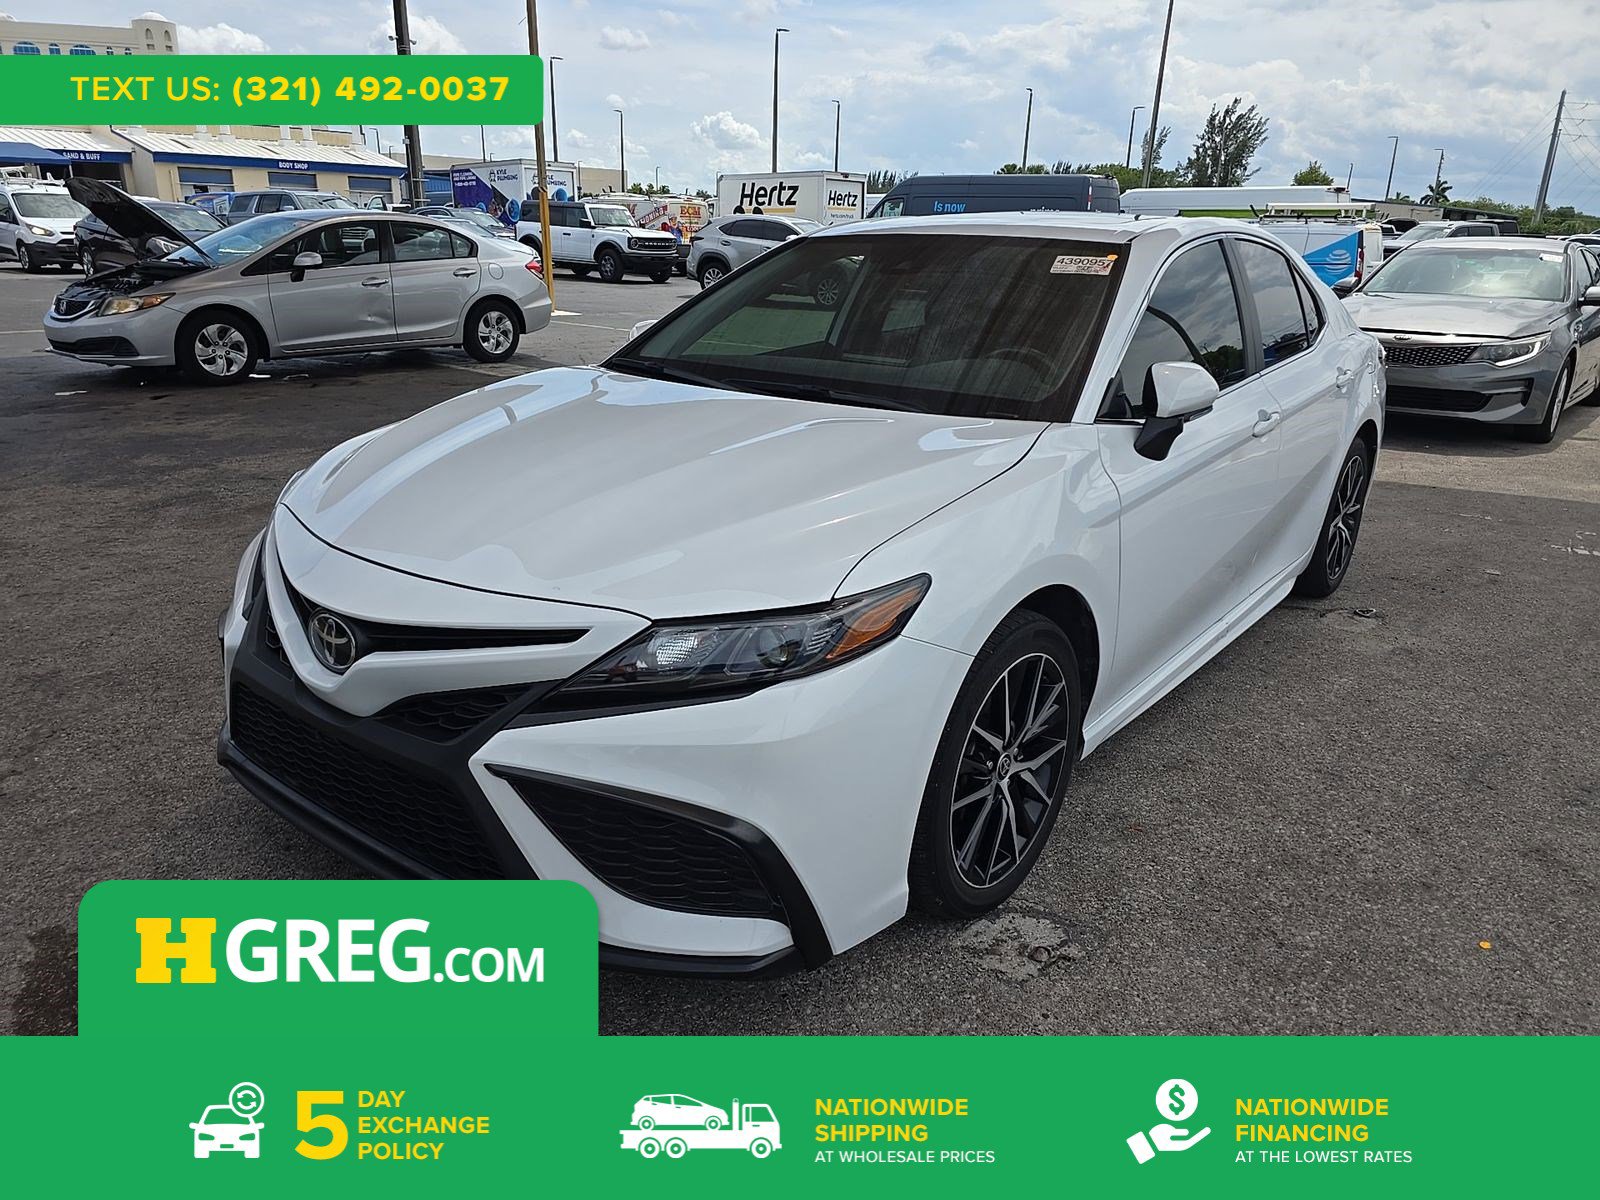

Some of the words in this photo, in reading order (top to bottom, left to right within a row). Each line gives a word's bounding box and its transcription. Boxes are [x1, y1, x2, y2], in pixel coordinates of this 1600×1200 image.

[278, 161, 293, 169] BODY
[294, 162, 308, 170] SHOP
[739, 181, 799, 206] Hertz
[828, 189, 858, 207] Hertz
[933, 200, 942, 212] Is
[944, 202, 966, 213] now
[1057, 258, 1113, 268] 4390957
